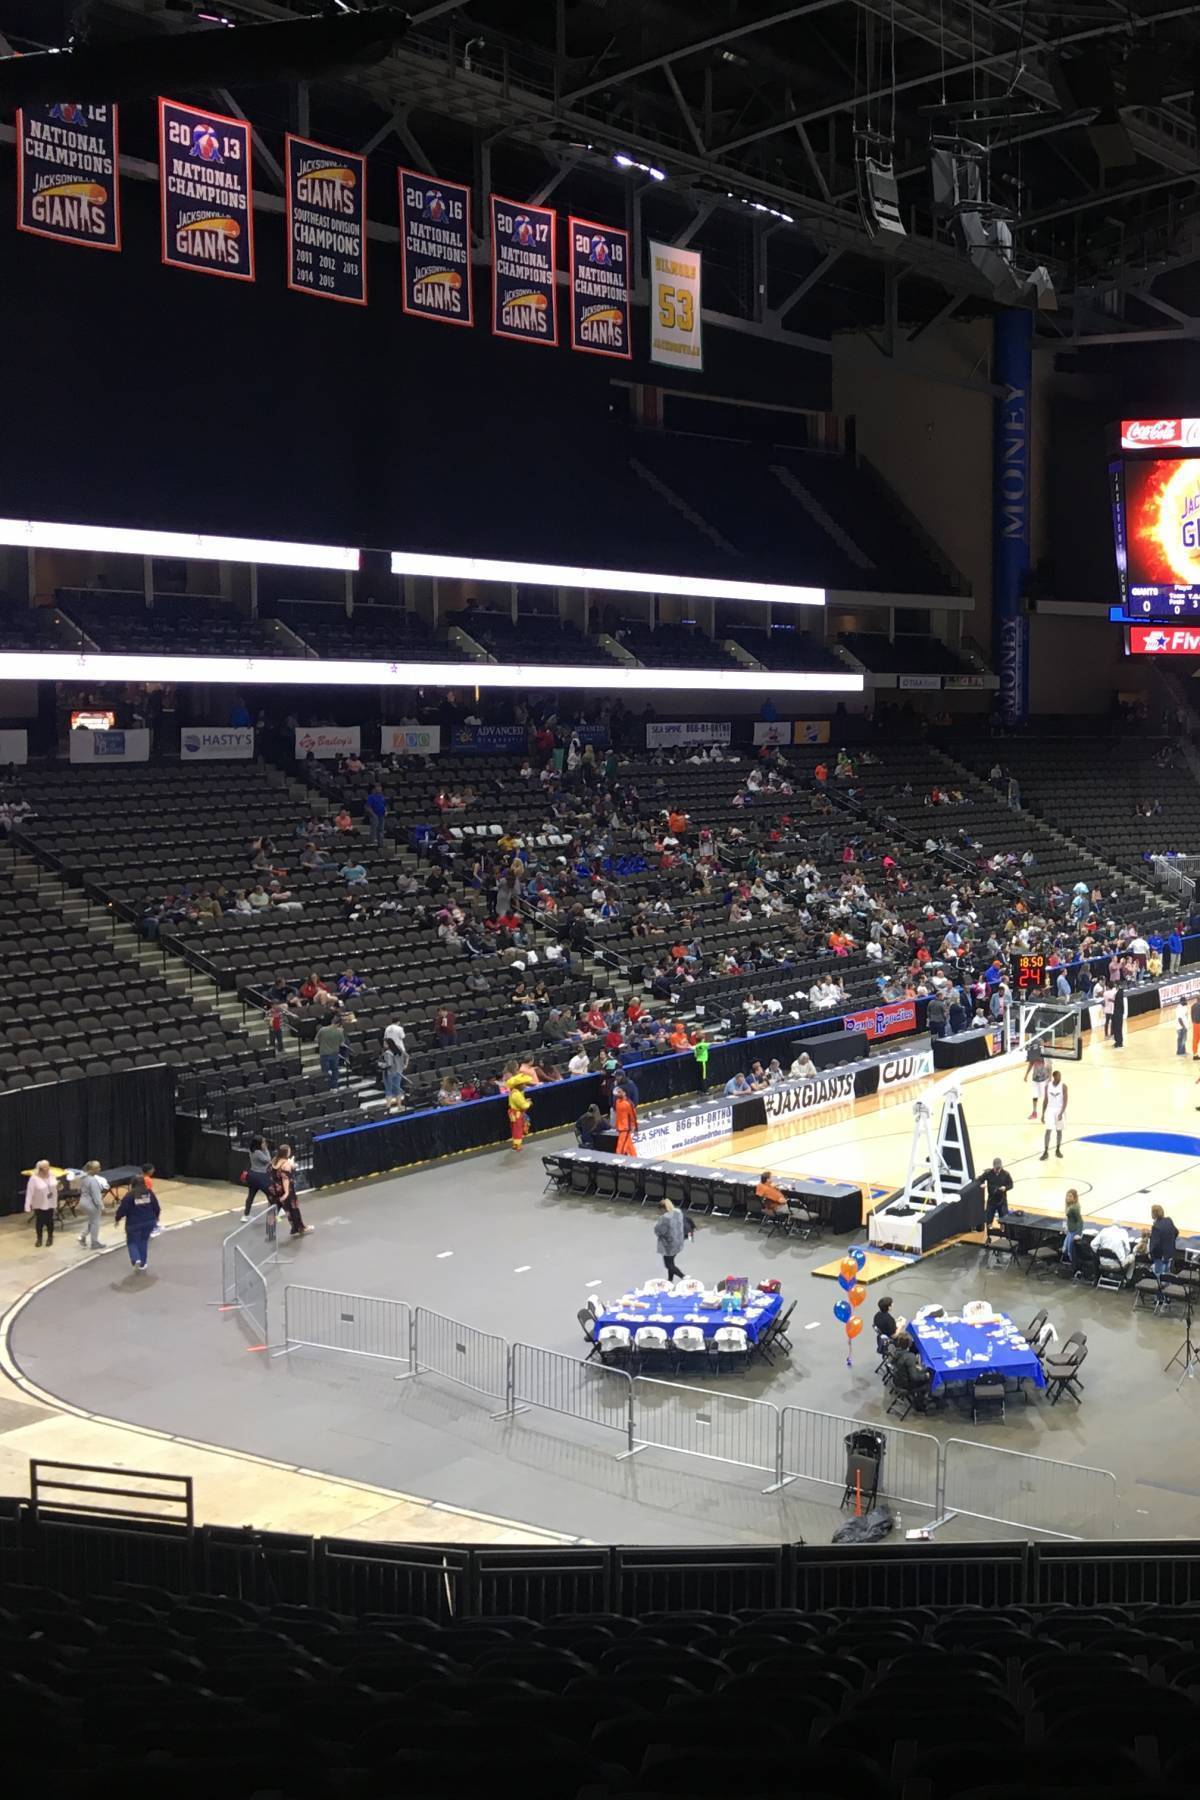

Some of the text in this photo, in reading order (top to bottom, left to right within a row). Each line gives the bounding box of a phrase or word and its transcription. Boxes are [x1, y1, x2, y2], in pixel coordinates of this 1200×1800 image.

[30, 120, 106, 155] NATIONAL
[168, 121, 241, 160] 20 13
[25, 138, 113, 174] CHAMPIONS
[172, 159, 241, 191] NATIONAL
[168, 176, 247, 210] CHAMPIONS
[297, 178, 355, 215] GIANTS
[406, 187, 424, 210] 20
[32, 195, 107, 235] GIANTS
[293, 207, 360, 237] SOUTHEAST DIVISION
[497, 213, 549, 242] 20 17
[176, 230, 240, 264] GIANTS
[294, 222, 360, 257] CHAMPIONS
[410, 221, 463, 248] NATIONAL
[575, 234, 591, 254] 20
[296, 249, 359, 276] 2011 2012 2013
[406, 236, 467, 264] CHAMPIONS
[500, 245, 549, 269] NATIONAL
[297, 268, 314, 284] 2014
[497, 260, 553, 284] CHAMPIONS
[578, 265, 624, 287] NATIONAL
[413, 283, 461, 313] GIANTS
[575, 279, 627, 302] CHAMPIONS
[502, 306, 547, 333] GIANTS
[659, 284, 694, 332] 53
[580, 321, 623, 347] GIANTS
[1001, 383, 1025, 539] MONEY
[1143, 601, 1151, 612] 0
[202, 734, 252, 745] HASTY'S
[476, 727, 524, 736] ADVANCED
[1019, 968, 1041, 986] 24
[883, 1056, 914, 1083] CW
[766, 1072, 855, 1116] #JAXGIANTS
[632, 1132, 647, 1144] SEA
[649, 1126, 670, 1140] SPINE
[675, 1106, 732, 1132] 866-81-ORTHO
